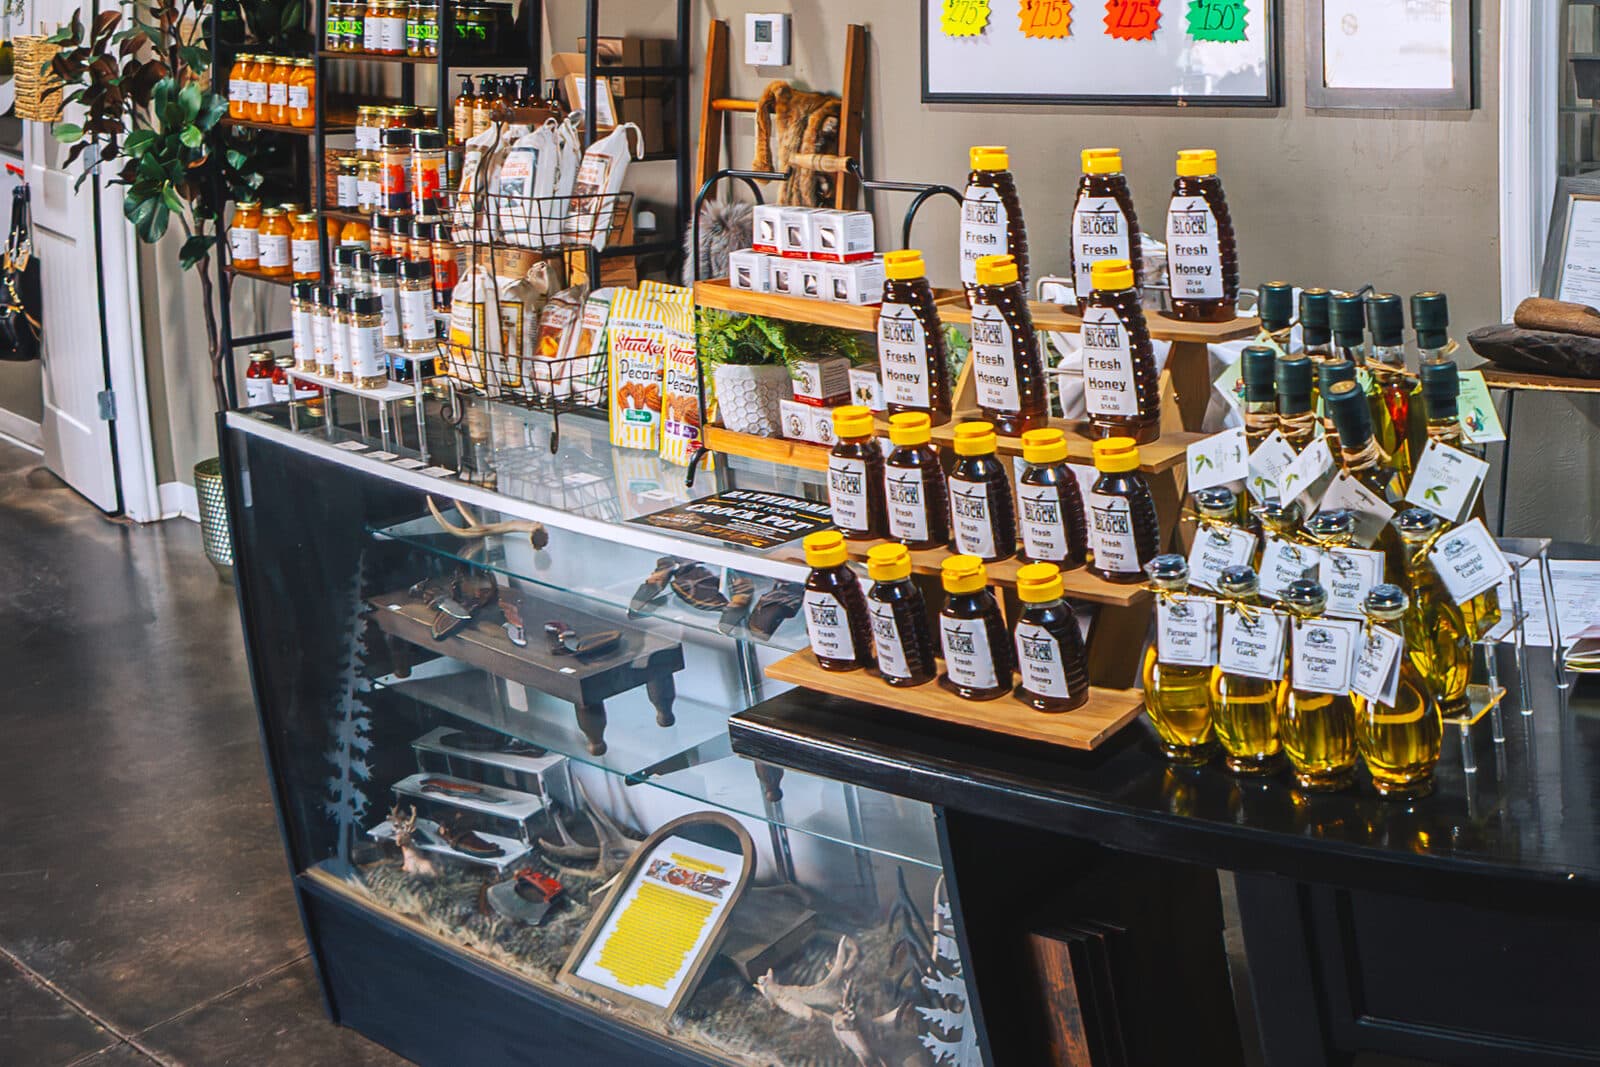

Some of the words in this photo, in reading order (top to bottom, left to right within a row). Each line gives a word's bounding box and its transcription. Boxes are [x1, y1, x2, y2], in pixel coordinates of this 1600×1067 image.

[1081, 220, 1117, 234] BLOCK
[1173, 220, 1206, 234] BLOCK
[966, 231, 997, 244] Fresh
[1083, 244, 1118, 255] Fresh
[1175, 244, 1208, 255] Fresh
[1175, 263, 1212, 276] Honey
[884, 327, 914, 342] BLOCK
[1086, 332, 1119, 348] BLOCK
[885, 350, 916, 364] Fresh
[976, 351, 1005, 366] Fresh
[1088, 357, 1121, 369] Fresh
[667, 369, 698, 394] Pecan
[887, 368, 921, 383] Honey
[977, 370, 1009, 386] Honey
[1088, 377, 1126, 392] Honey
[831, 478, 860, 494] BLOCK
[836, 496, 854, 506] Fresh
[685, 503, 766, 520] CROCK
[755, 515, 816, 531] POT
[895, 507, 913, 517] Fresh
[1026, 507, 1057, 523] BLOCK
[1031, 527, 1052, 537] Fresh
[1095, 518, 1128, 534] BLOCK
[1101, 538, 1122, 548] Fresh
[1202, 552, 1230, 567] Roasted
[1453, 553, 1483, 573] Roasted
[1461, 563, 1483, 578] Garlic
[1332, 580, 1360, 591] Roasted
[1333, 589, 1355, 598] Garlic
[1167, 627, 1198, 638] Parmesan
[1171, 638, 1192, 646] Garlic
[1231, 637, 1266, 650] Parmesan
[1236, 647, 1259, 658] Garlic
[1302, 653, 1337, 665] Parmesan
[1307, 663, 1329, 673] Garlic
